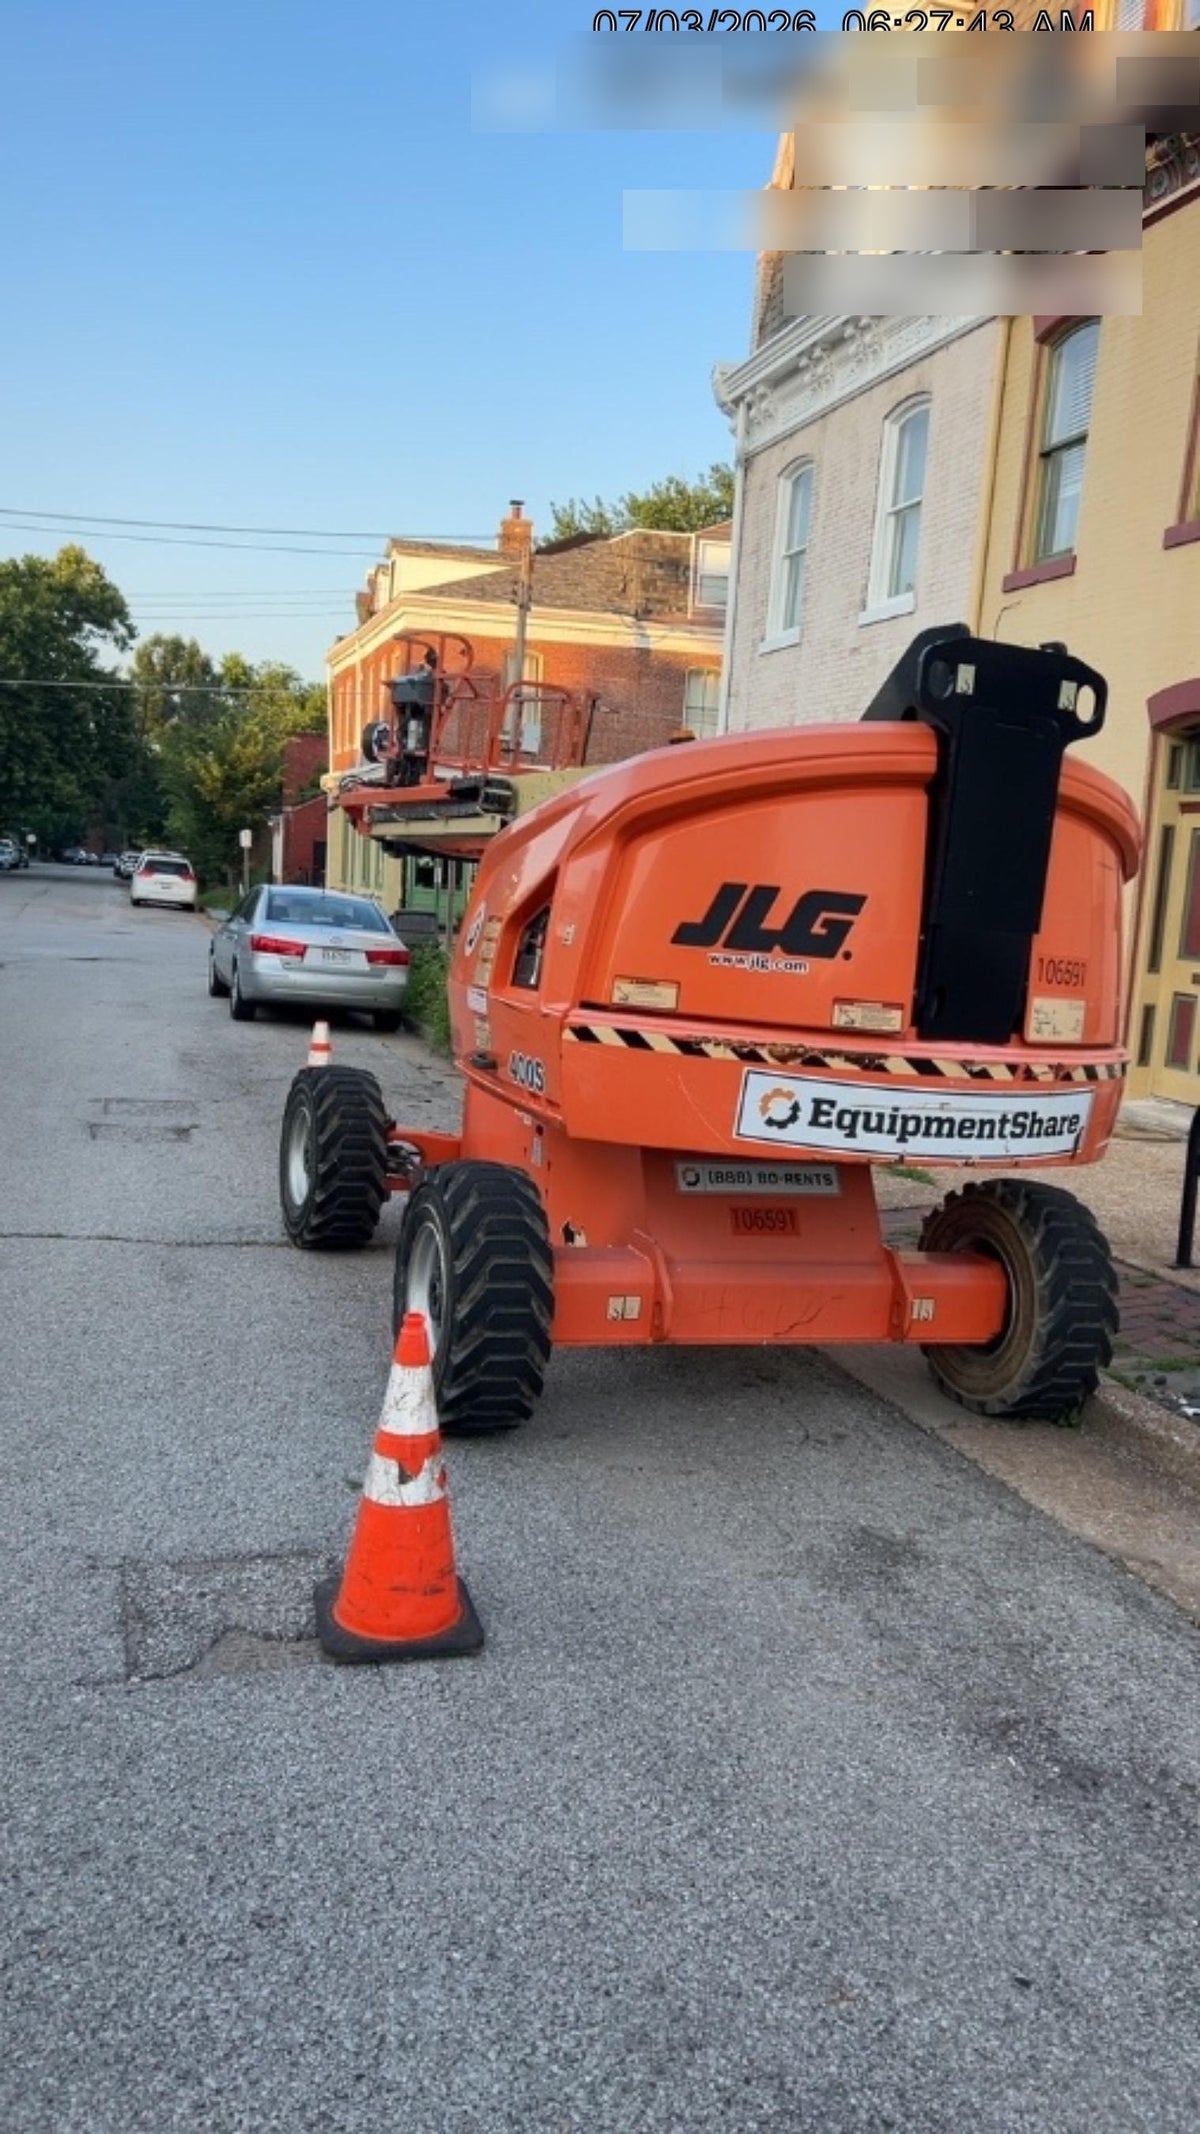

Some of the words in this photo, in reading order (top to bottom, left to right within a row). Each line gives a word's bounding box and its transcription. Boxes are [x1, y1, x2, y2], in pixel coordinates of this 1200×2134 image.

[670, 881, 869, 960] JLG
[707, 953, 808, 974] www.jlg.com
[1037, 957, 1088, 988] 106591
[509, 1051, 545, 1092] 400S
[808, 1097, 1081, 1144] EquipmentShare
[708, 1170, 752, 1186] (888)
[732, 1207, 798, 1231] 106591
